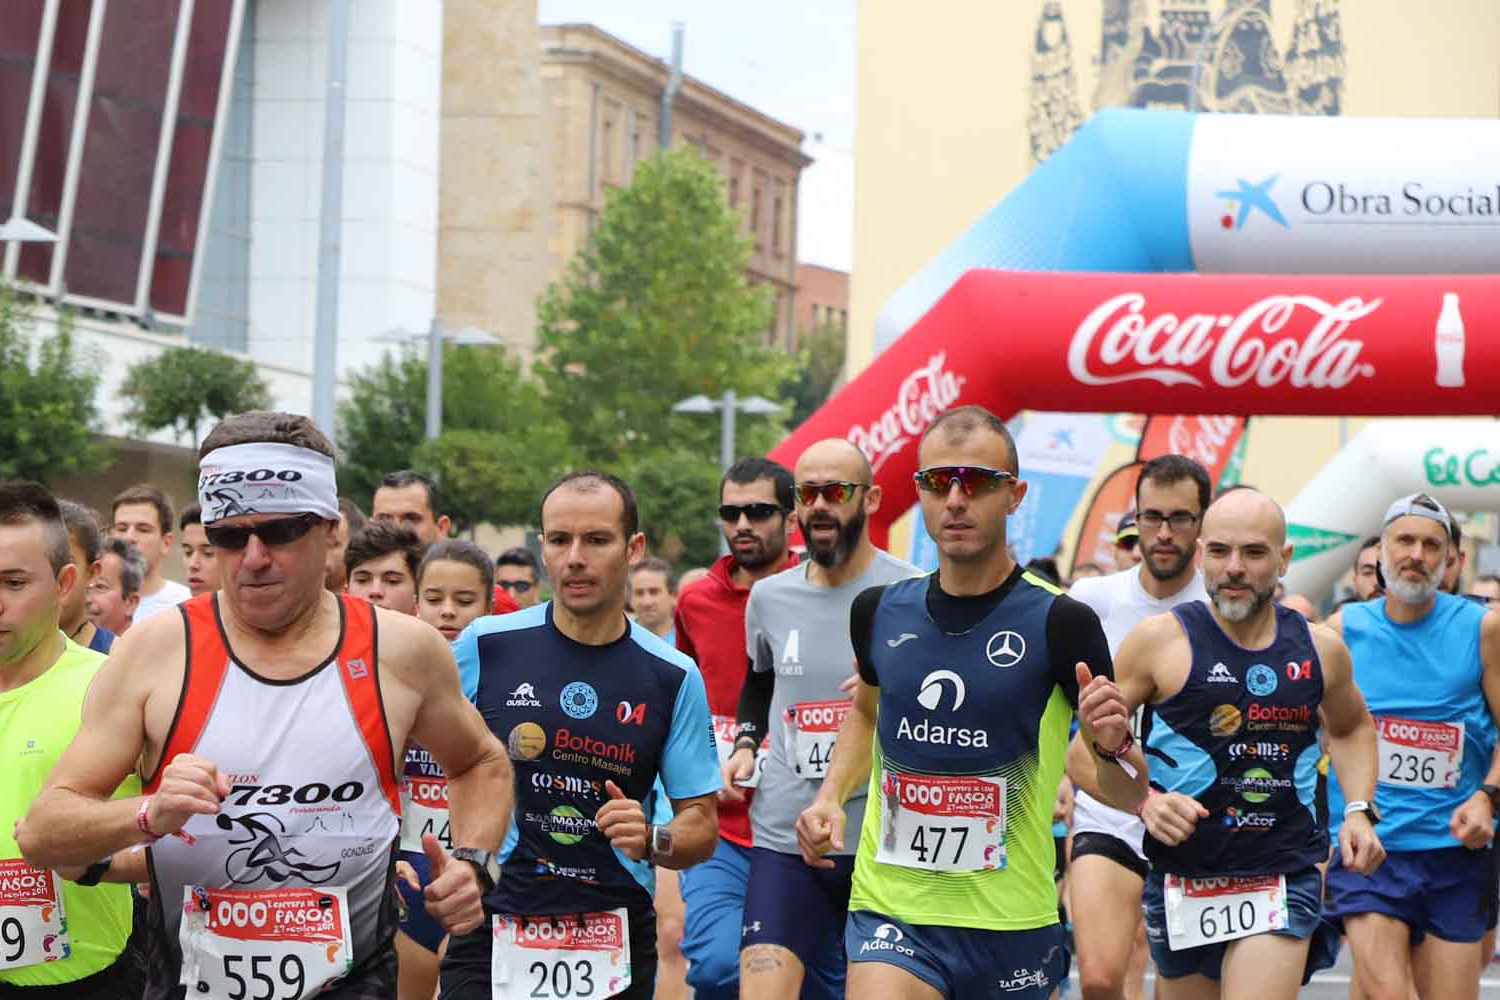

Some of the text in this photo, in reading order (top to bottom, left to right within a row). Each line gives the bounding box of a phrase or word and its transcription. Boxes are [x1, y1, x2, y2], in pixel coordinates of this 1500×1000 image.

[1301, 181, 1500, 217] Obra Social
[1067, 292, 1384, 388] Coca-Cola
[1424, 448, 1461, 487] El
[554, 728, 636, 763] Botanik
[897, 717, 988, 748] Adarsa
[405, 750, 436, 763] CLU
[552, 749, 590, 766] Centro
[1389, 753, 1436, 783] 236
[219, 781, 364, 806] 7300
[948, 793, 994, 804] PASOS
[525, 812, 599, 828] SANMAXIM
[910, 826, 970, 865] 477
[275, 908, 333, 924] PASOS
[1200, 901, 1255, 938] 610
[530, 961, 594, 998] 203
